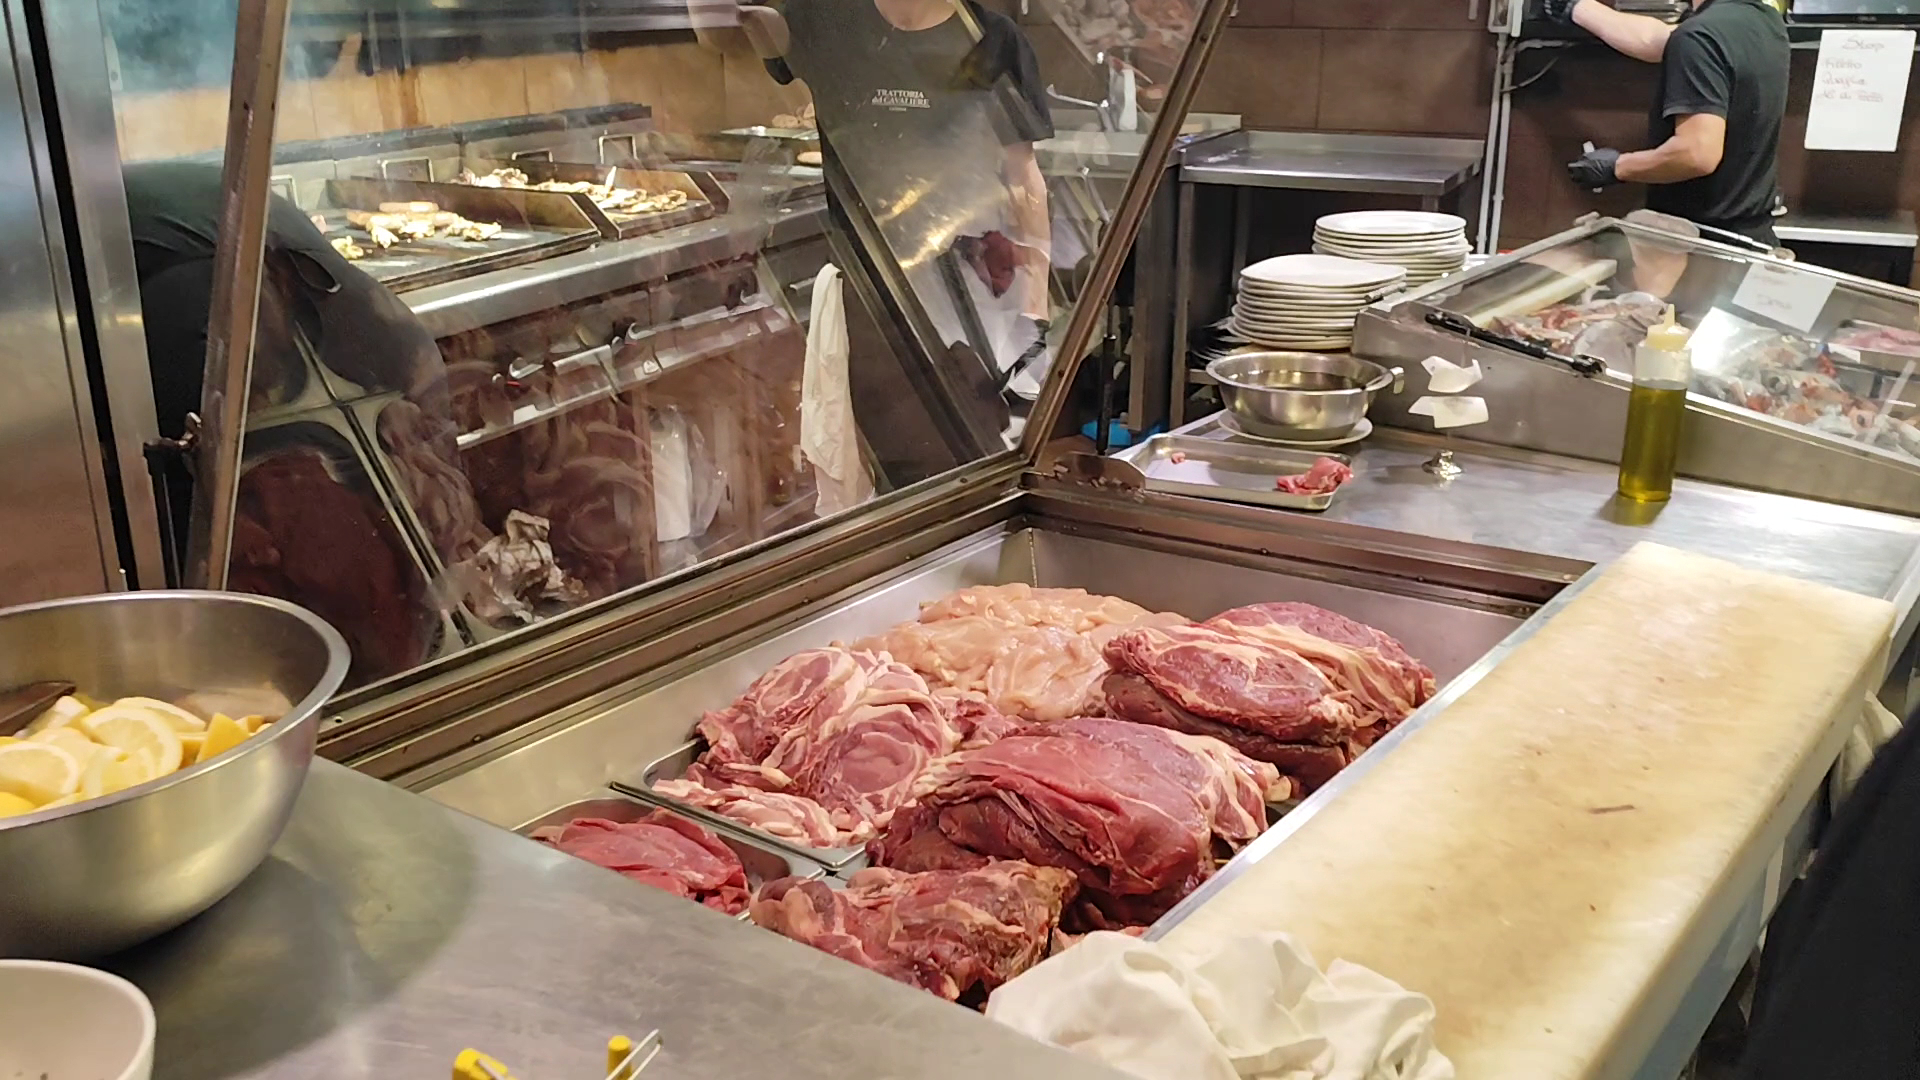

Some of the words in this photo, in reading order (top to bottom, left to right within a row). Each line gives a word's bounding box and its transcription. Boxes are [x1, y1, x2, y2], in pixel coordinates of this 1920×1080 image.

[1842, 35, 1885, 52] Stop
[876, 89, 924, 98] TRATTORIA
[883, 97, 929, 105] CAVALIERE
